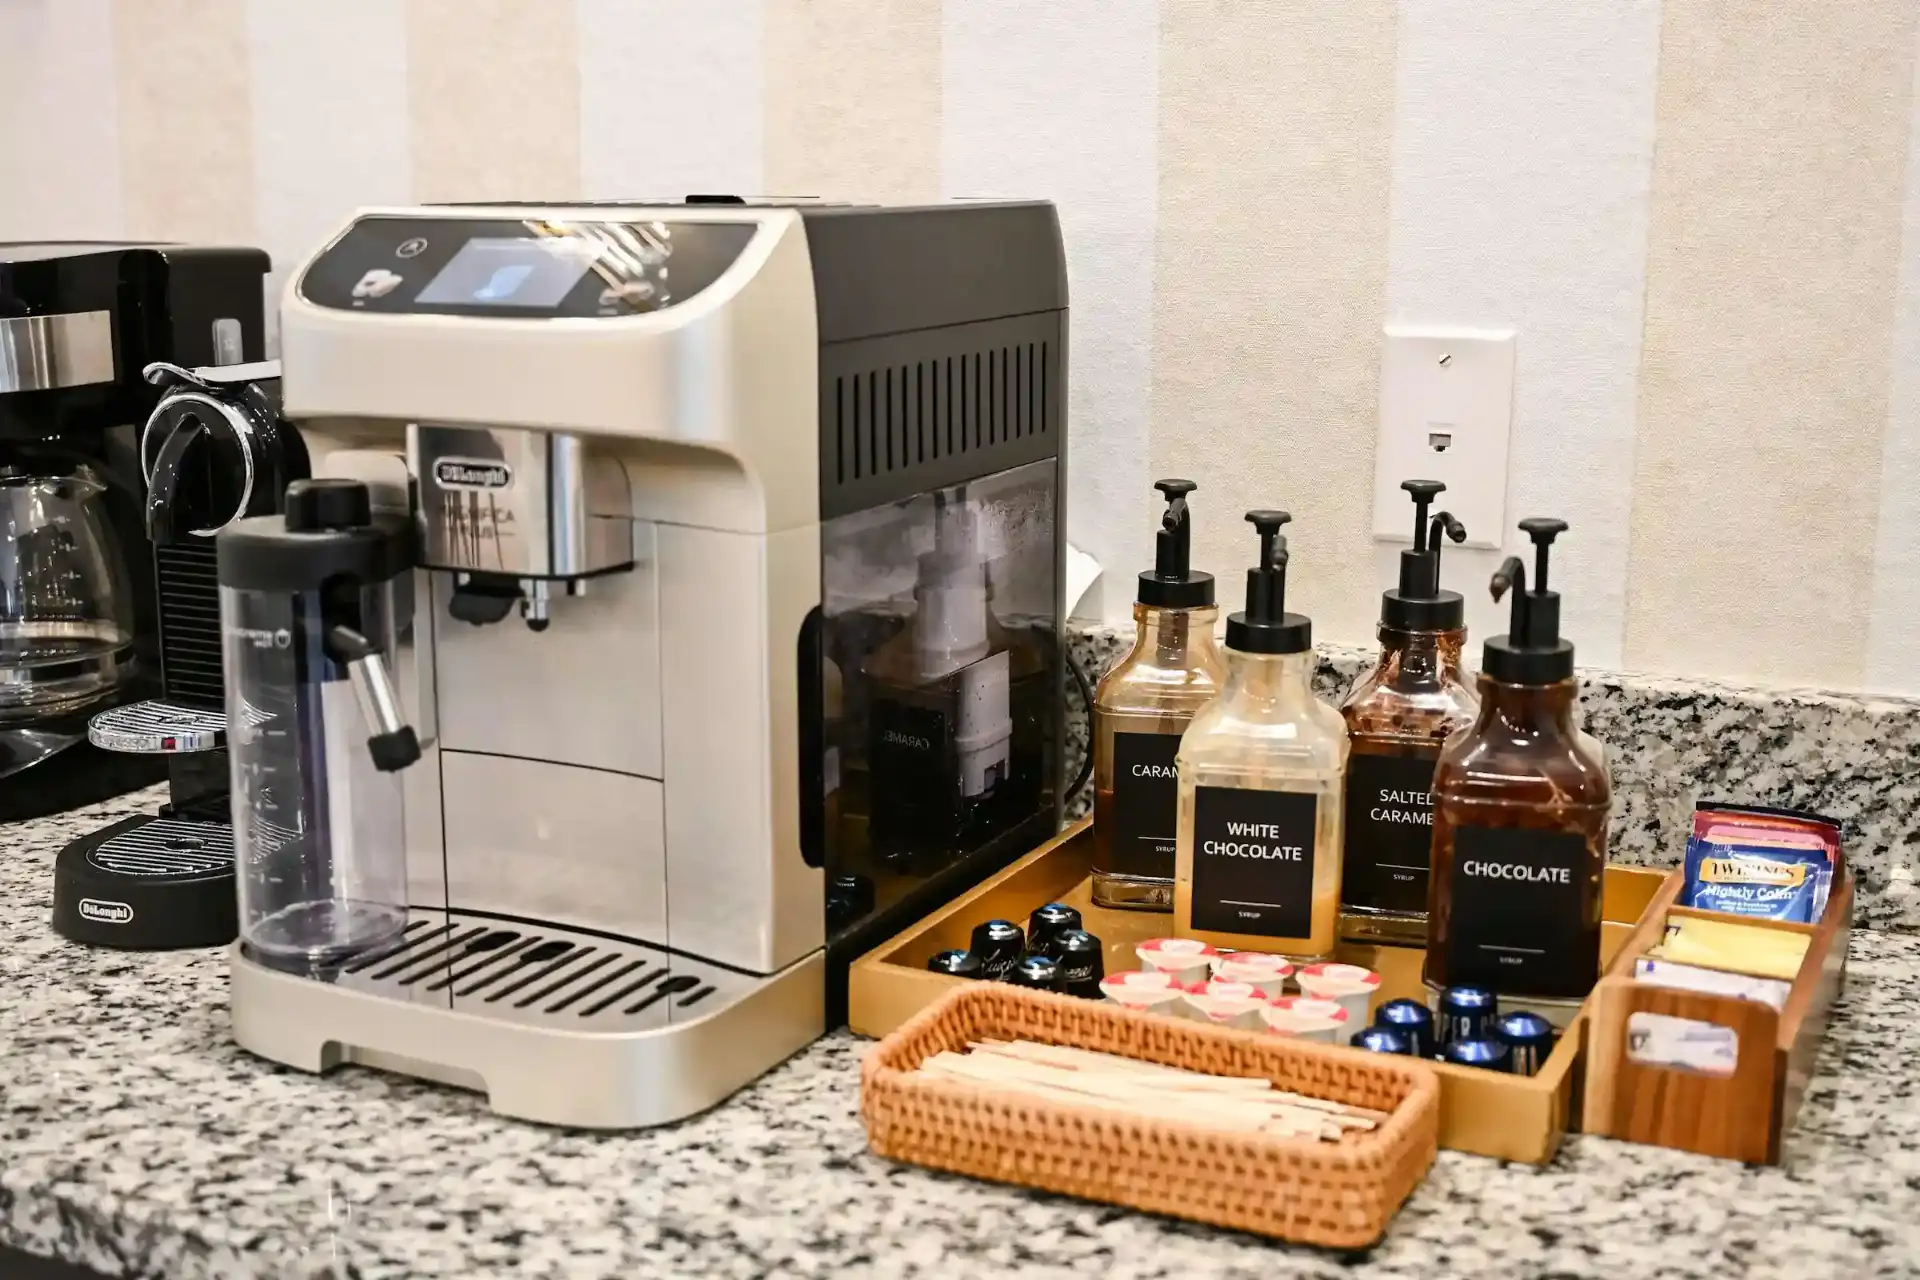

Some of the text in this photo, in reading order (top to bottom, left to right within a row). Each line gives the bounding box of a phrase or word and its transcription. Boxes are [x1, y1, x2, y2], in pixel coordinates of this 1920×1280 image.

[1132, 764, 1180, 778] CARAM
[1370, 808, 1434, 826] CARAME
[1226, 821, 1280, 839] WHITE
[1203, 840, 1303, 861] CHOCOLATE
[1393, 873, 1415, 881] SYRUP
[1463, 860, 1571, 884] CHOCOLATE
